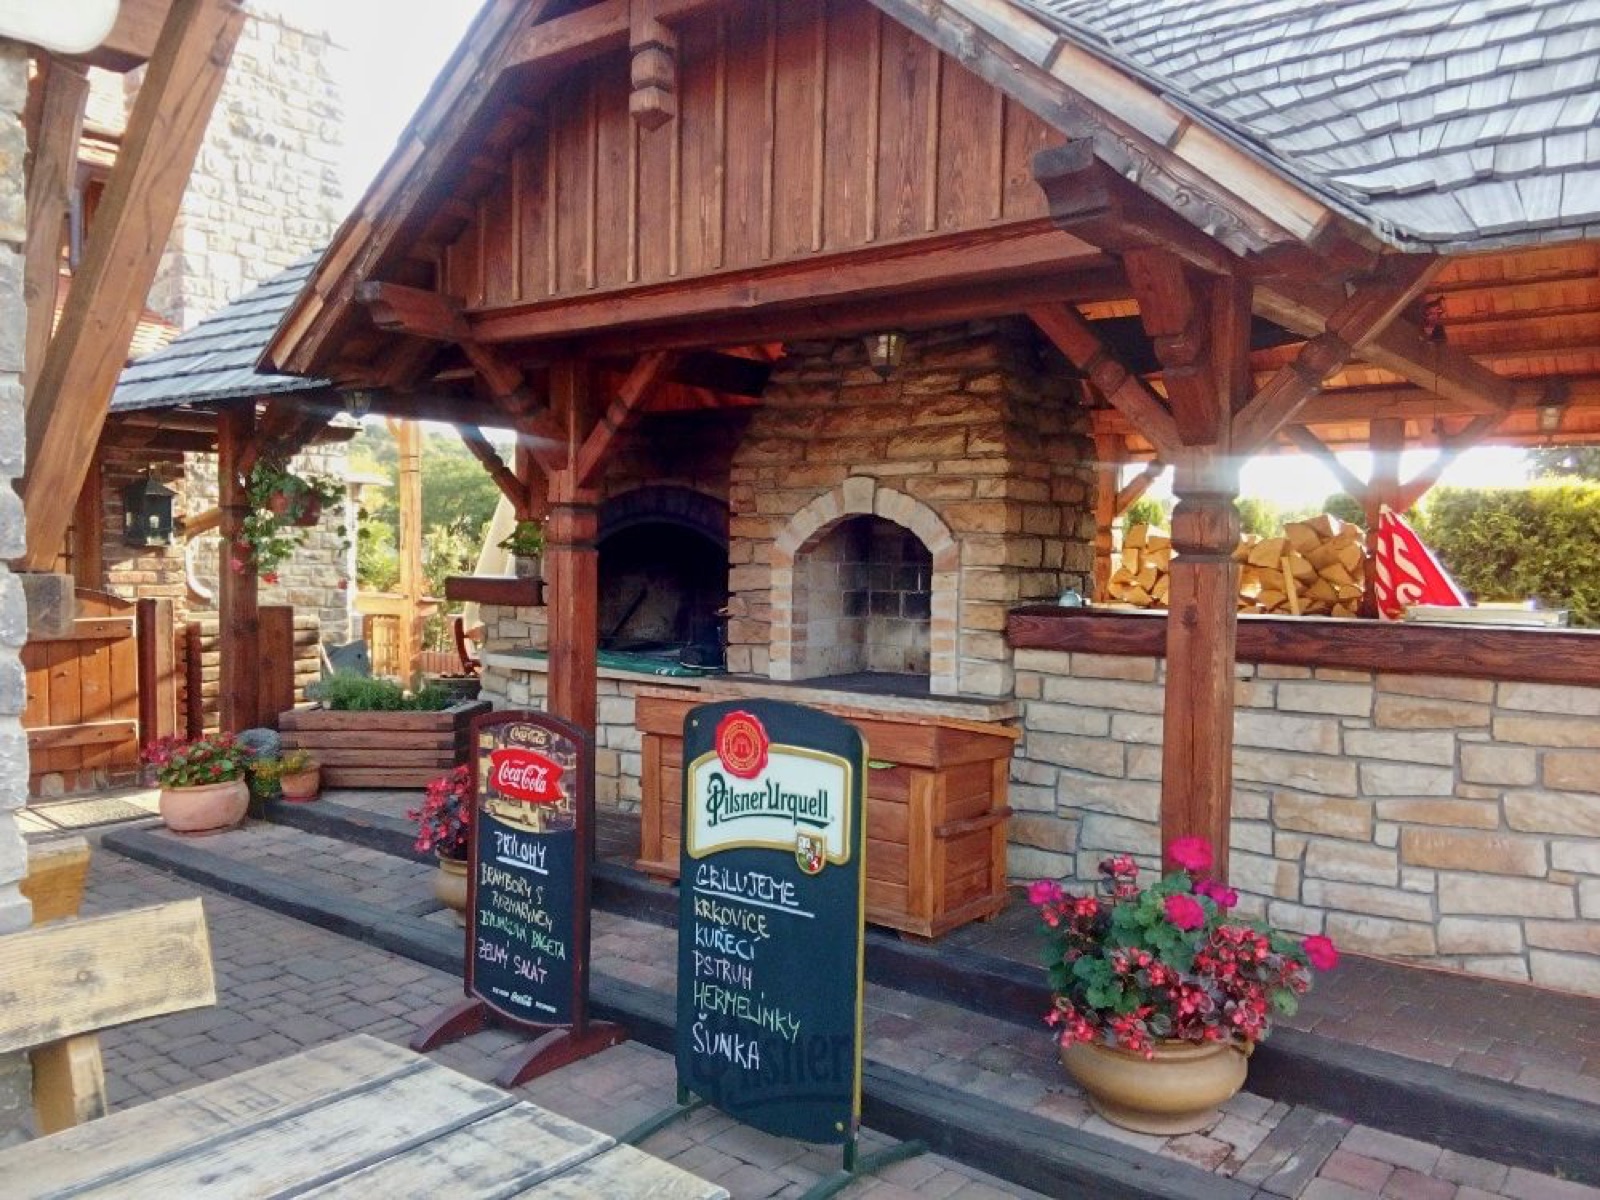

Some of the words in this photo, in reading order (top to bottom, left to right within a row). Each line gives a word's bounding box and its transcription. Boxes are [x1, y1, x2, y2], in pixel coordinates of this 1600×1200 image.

[498, 759, 549, 793] Coca-Cola
[705, 772, 768, 828] Pilsner
[766, 780, 829, 826] Urquell
[691, 948, 753, 991] PSTRUH
[692, 1012, 760, 1071] ŠUNKA
